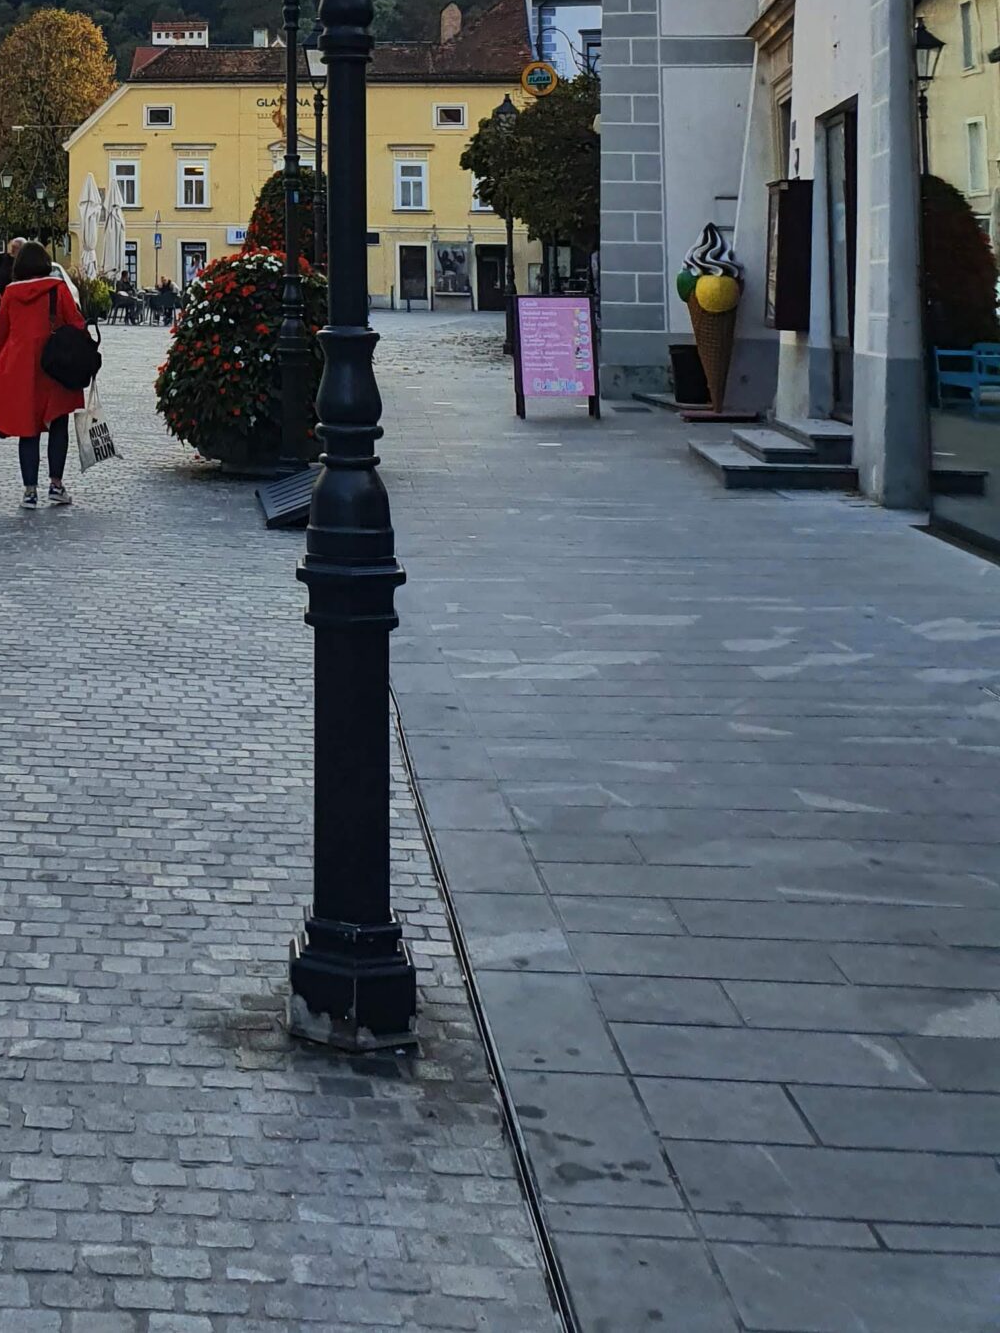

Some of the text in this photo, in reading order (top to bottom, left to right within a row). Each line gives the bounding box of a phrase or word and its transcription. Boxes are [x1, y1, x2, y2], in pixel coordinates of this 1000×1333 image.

[256, 98, 311, 107] GLANA
[89, 422, 110, 439] MUM
[94, 440, 116, 462] RUN
